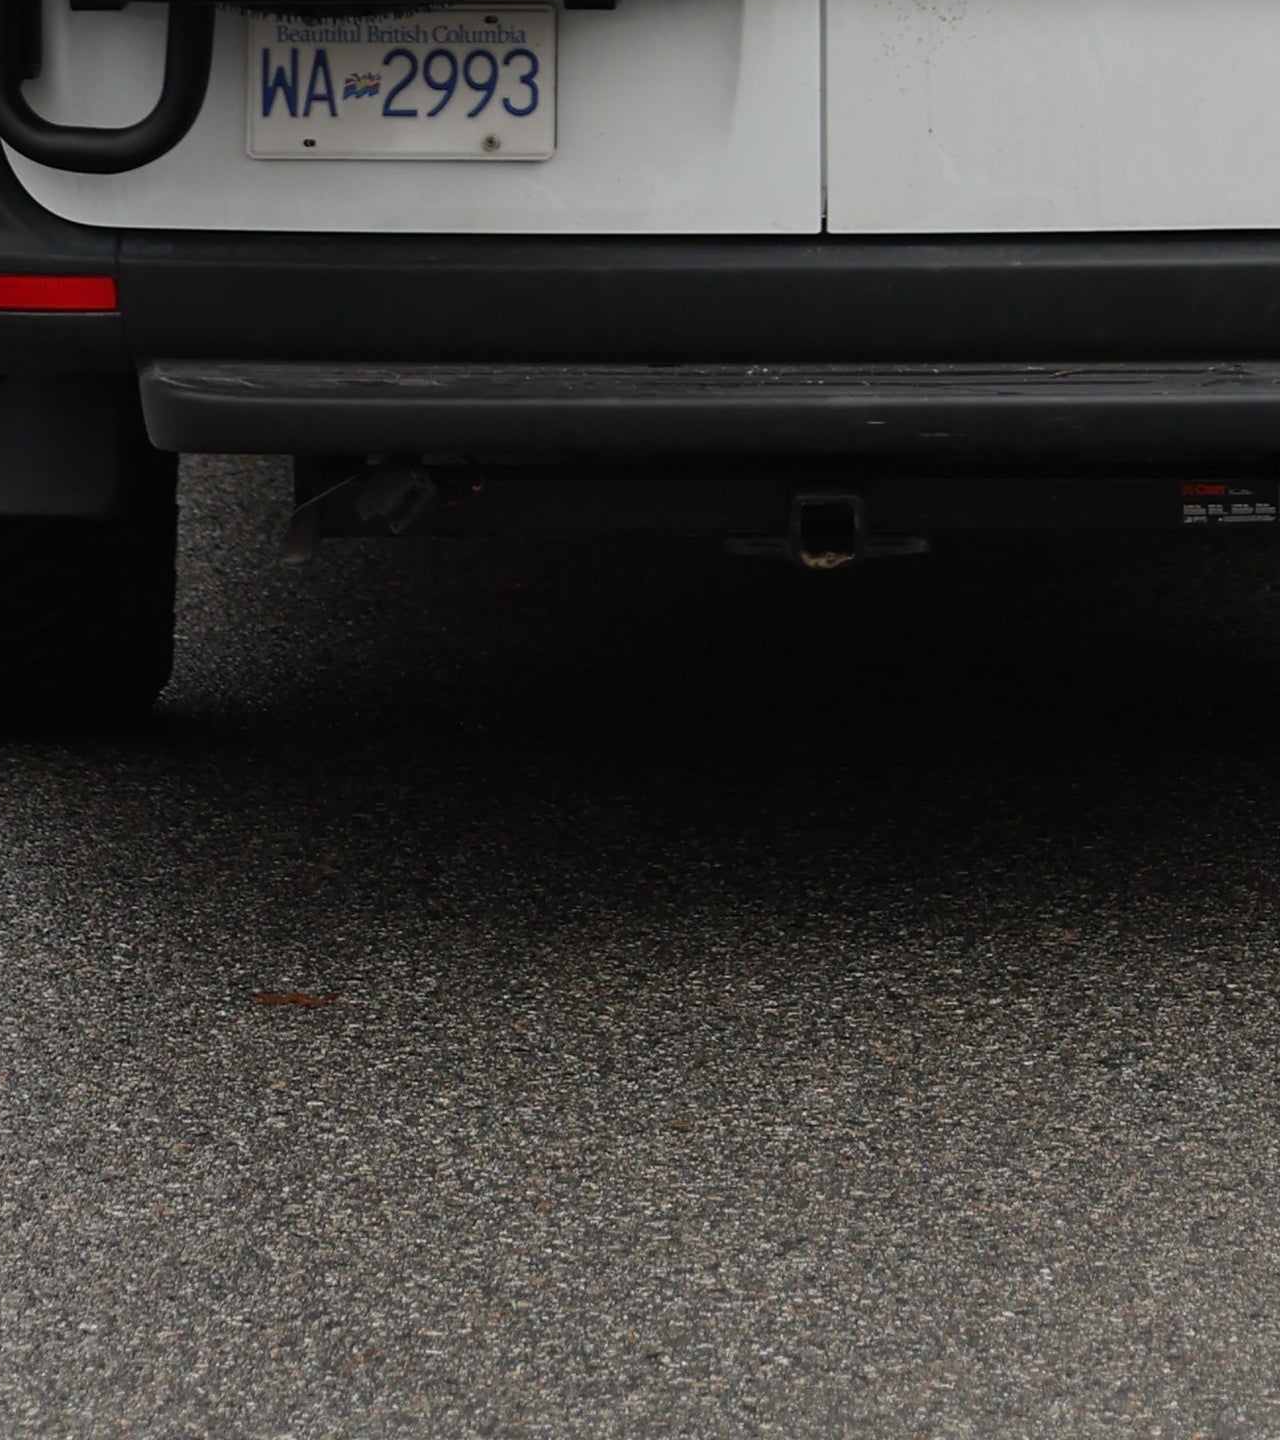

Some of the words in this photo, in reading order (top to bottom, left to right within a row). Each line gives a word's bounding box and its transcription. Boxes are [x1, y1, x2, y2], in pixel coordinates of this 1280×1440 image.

[276, 25, 361, 44] Beautiful
[367, 25, 426, 44] British
[432, 25, 527, 44] Columbia
[262, 48, 338, 118] WA
[381, 48, 539, 118] 2993
